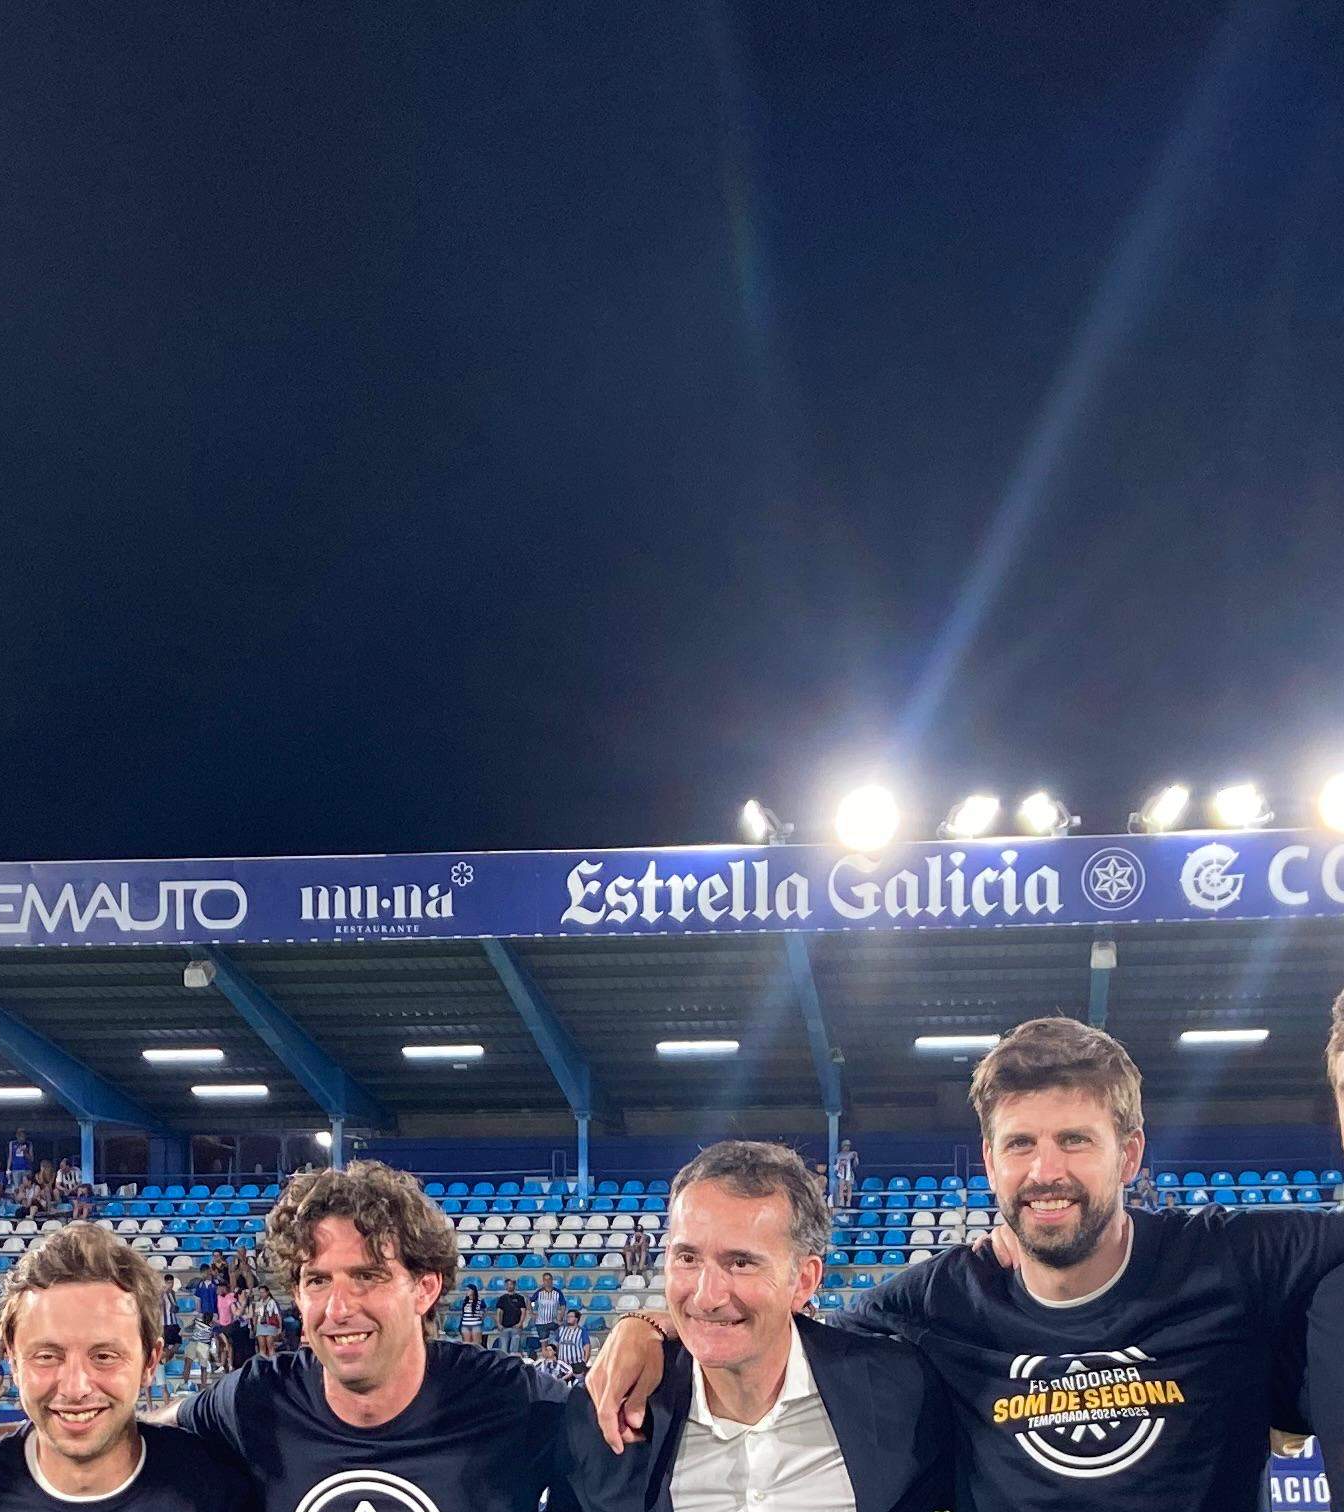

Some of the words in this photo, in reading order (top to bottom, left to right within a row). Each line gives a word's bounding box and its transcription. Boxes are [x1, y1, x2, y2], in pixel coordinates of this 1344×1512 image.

[560, 859, 813, 925] Estrella
[828, 850, 1064, 920] Galicia
[335, 924, 420, 934] RESTAURANTE
[1029, 1379, 1050, 1394] FC
[1051, 1366, 1141, 1392] ANDORRA
[993, 1392, 1046, 1423] SOM
[1050, 1389, 1080, 1414] DE
[1084, 1380, 1185, 1410] SEGONA
[1028, 1409, 1090, 1429] TEMPORADA
